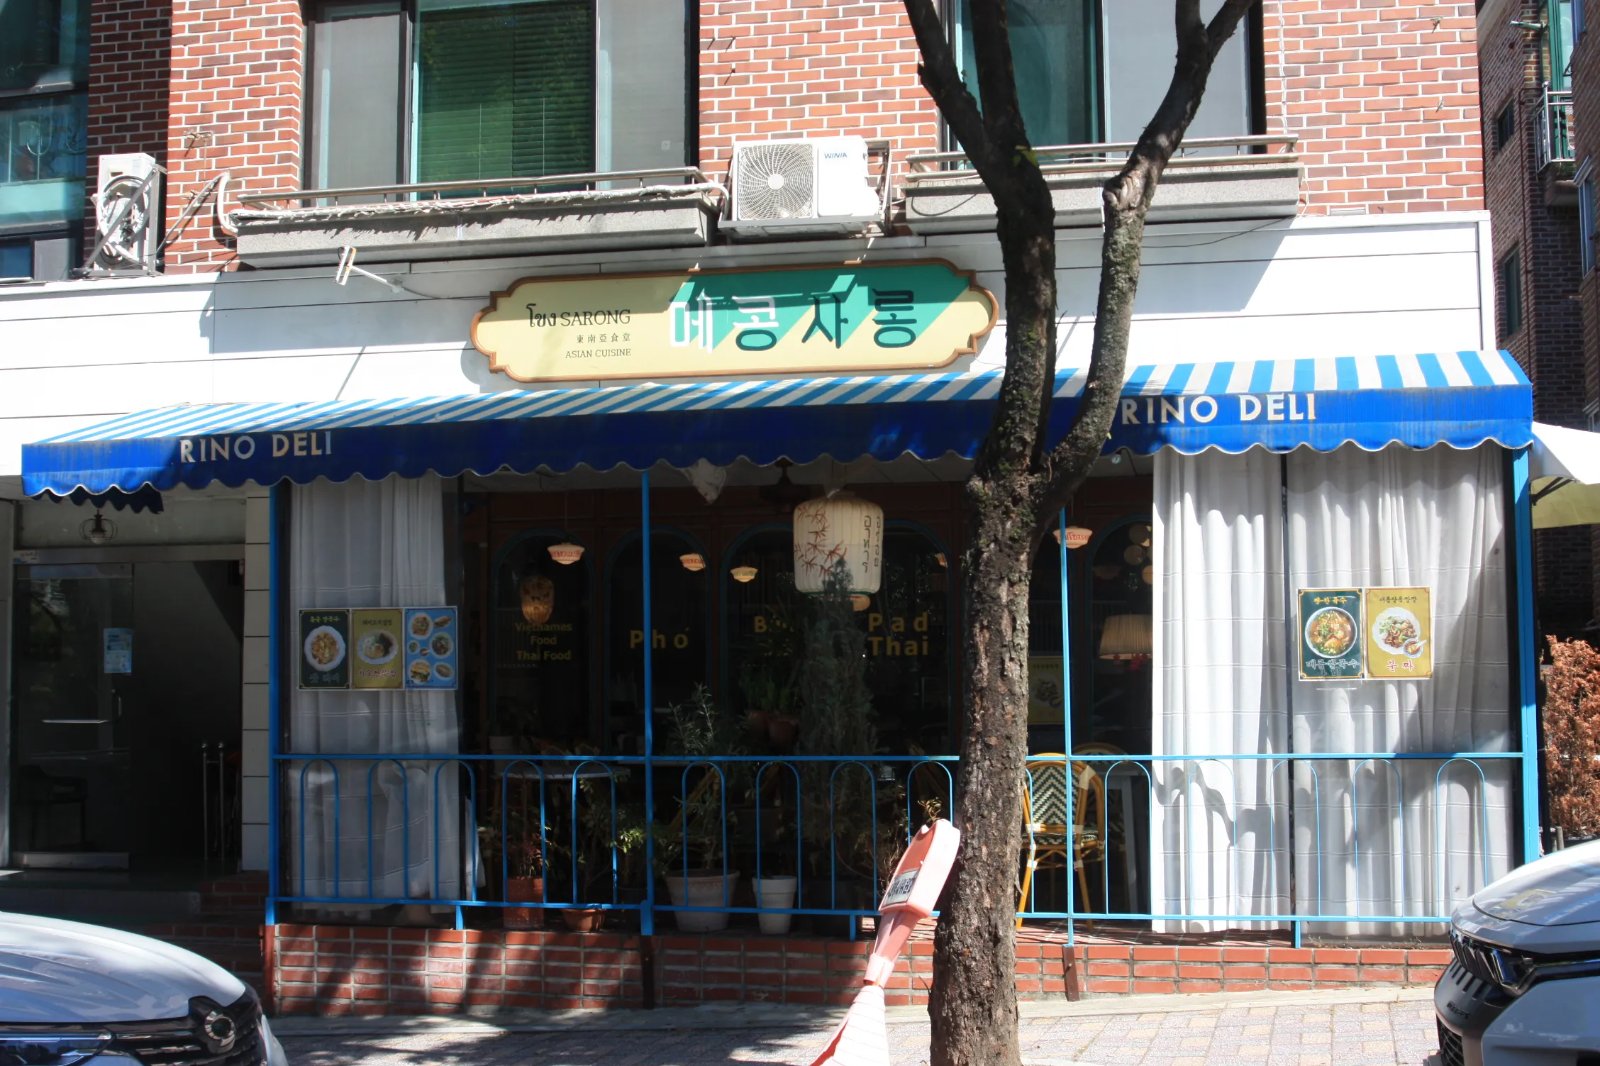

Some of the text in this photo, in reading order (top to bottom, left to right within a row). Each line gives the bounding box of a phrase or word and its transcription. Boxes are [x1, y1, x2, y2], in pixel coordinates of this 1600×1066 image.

[560, 309, 631, 327] SARONG
[565, 348, 632, 359] ASIAN CUISINE
[1121, 393, 1316, 425] RINO DELI
[180, 431, 332, 463] RINO DELI
[868, 611, 929, 633] Pad
[530, 634, 557, 646] Food
[867, 636, 929, 656] Thai
[543, 649, 572, 661] Food
